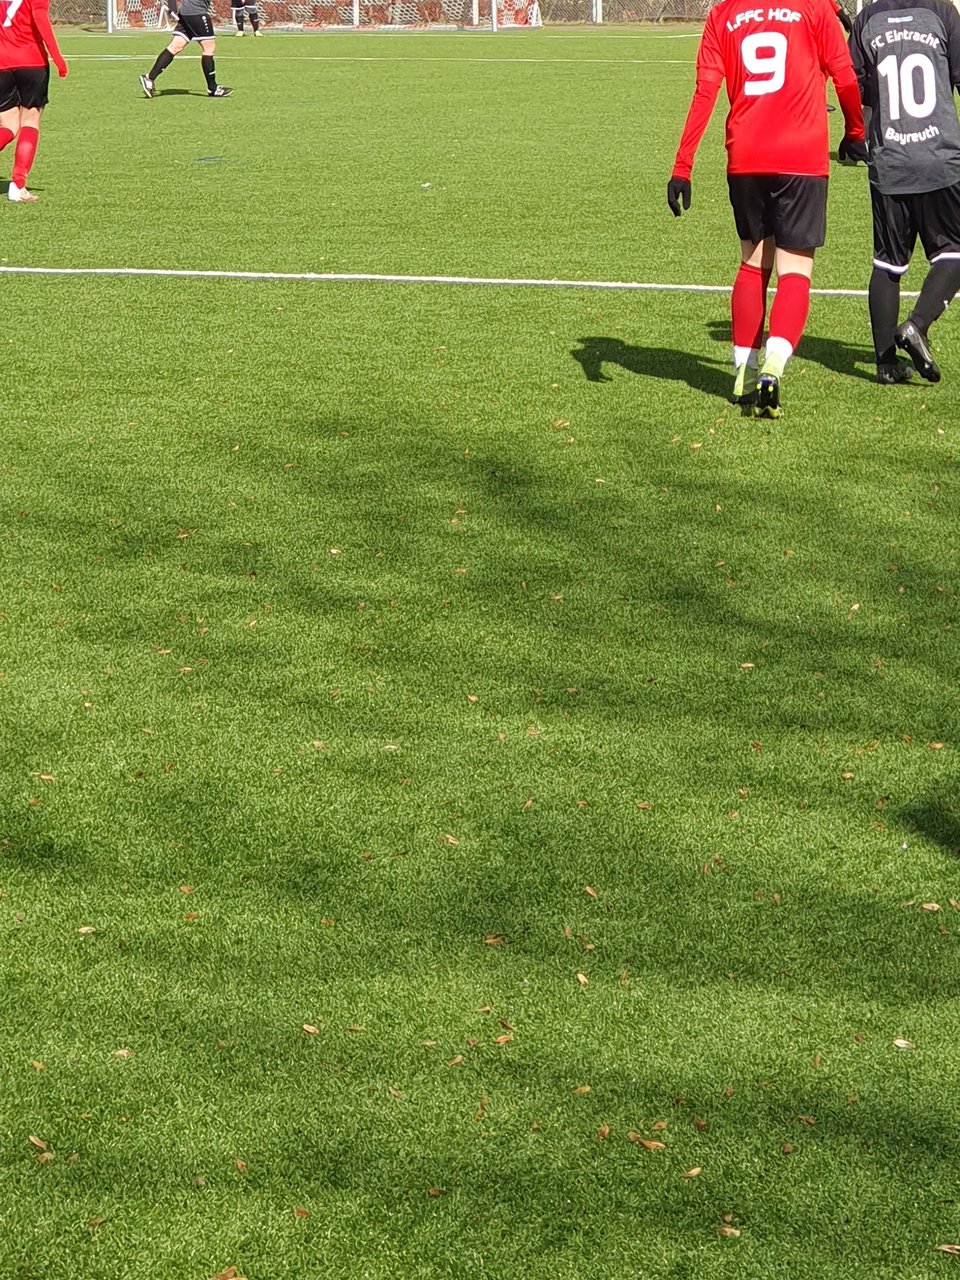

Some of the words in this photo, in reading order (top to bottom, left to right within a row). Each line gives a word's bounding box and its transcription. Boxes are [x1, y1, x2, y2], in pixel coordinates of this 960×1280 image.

[768, 7, 802, 23] HOF
[885, 29, 940, 49] Eintracht
[741, 31, 788, 96] 9
[877, 53, 937, 120] 10
[885, 124, 940, 146] Bayreuth
